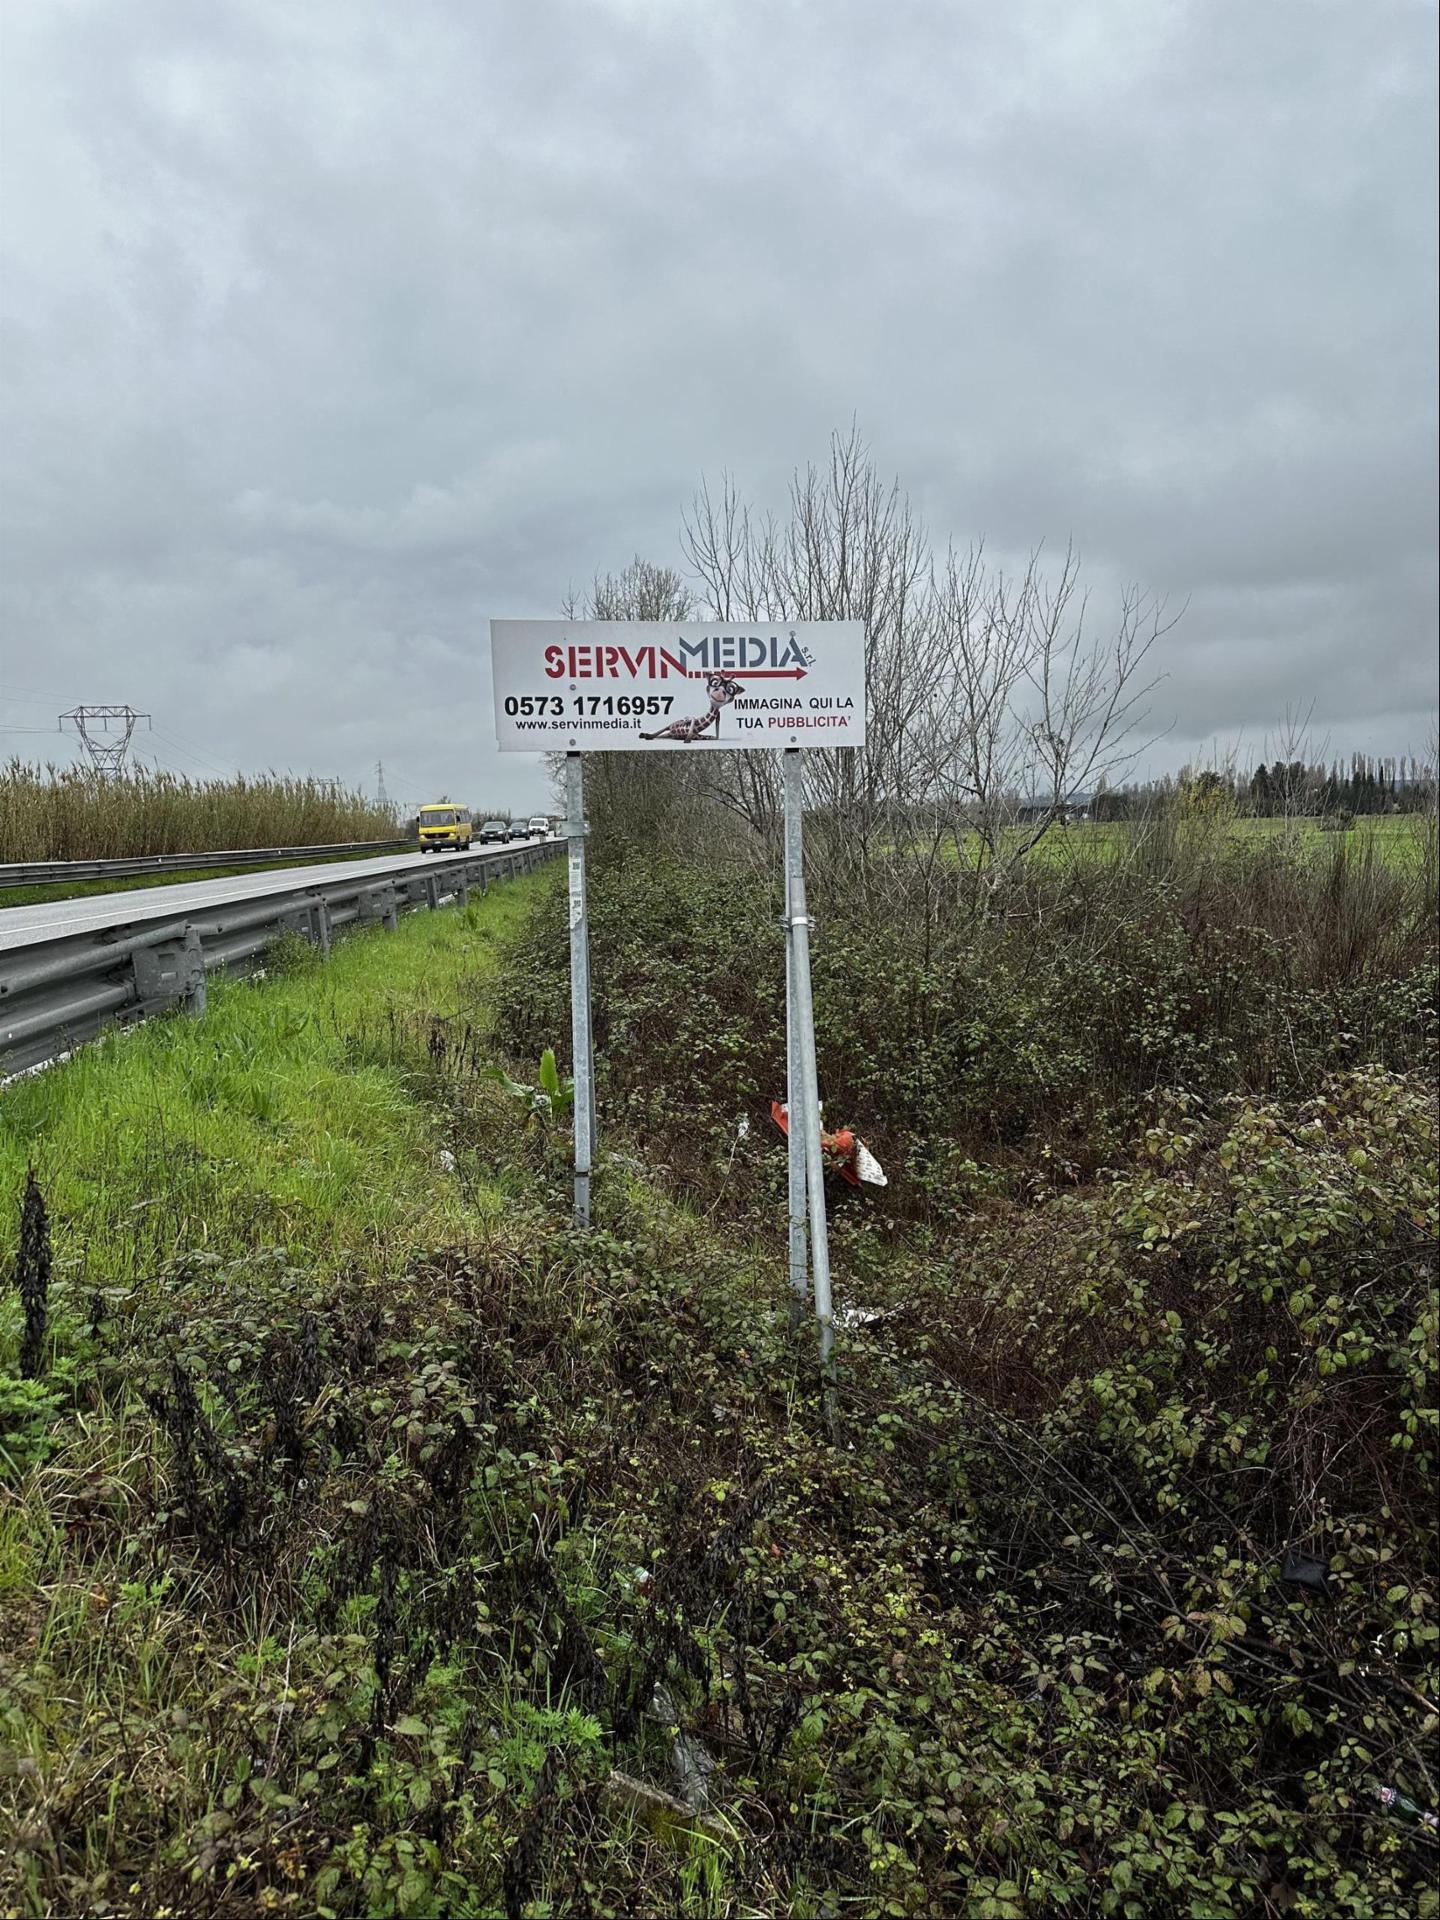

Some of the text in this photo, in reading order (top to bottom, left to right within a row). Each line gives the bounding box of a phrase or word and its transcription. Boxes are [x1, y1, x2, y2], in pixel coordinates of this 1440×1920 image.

[504, 696, 675, 716] 0573 1716957
[734, 697, 854, 710] IMMAGINA QUI LA
[515, 717, 642, 730] www.servinmedia.it
[736, 717, 764, 729] TUA
